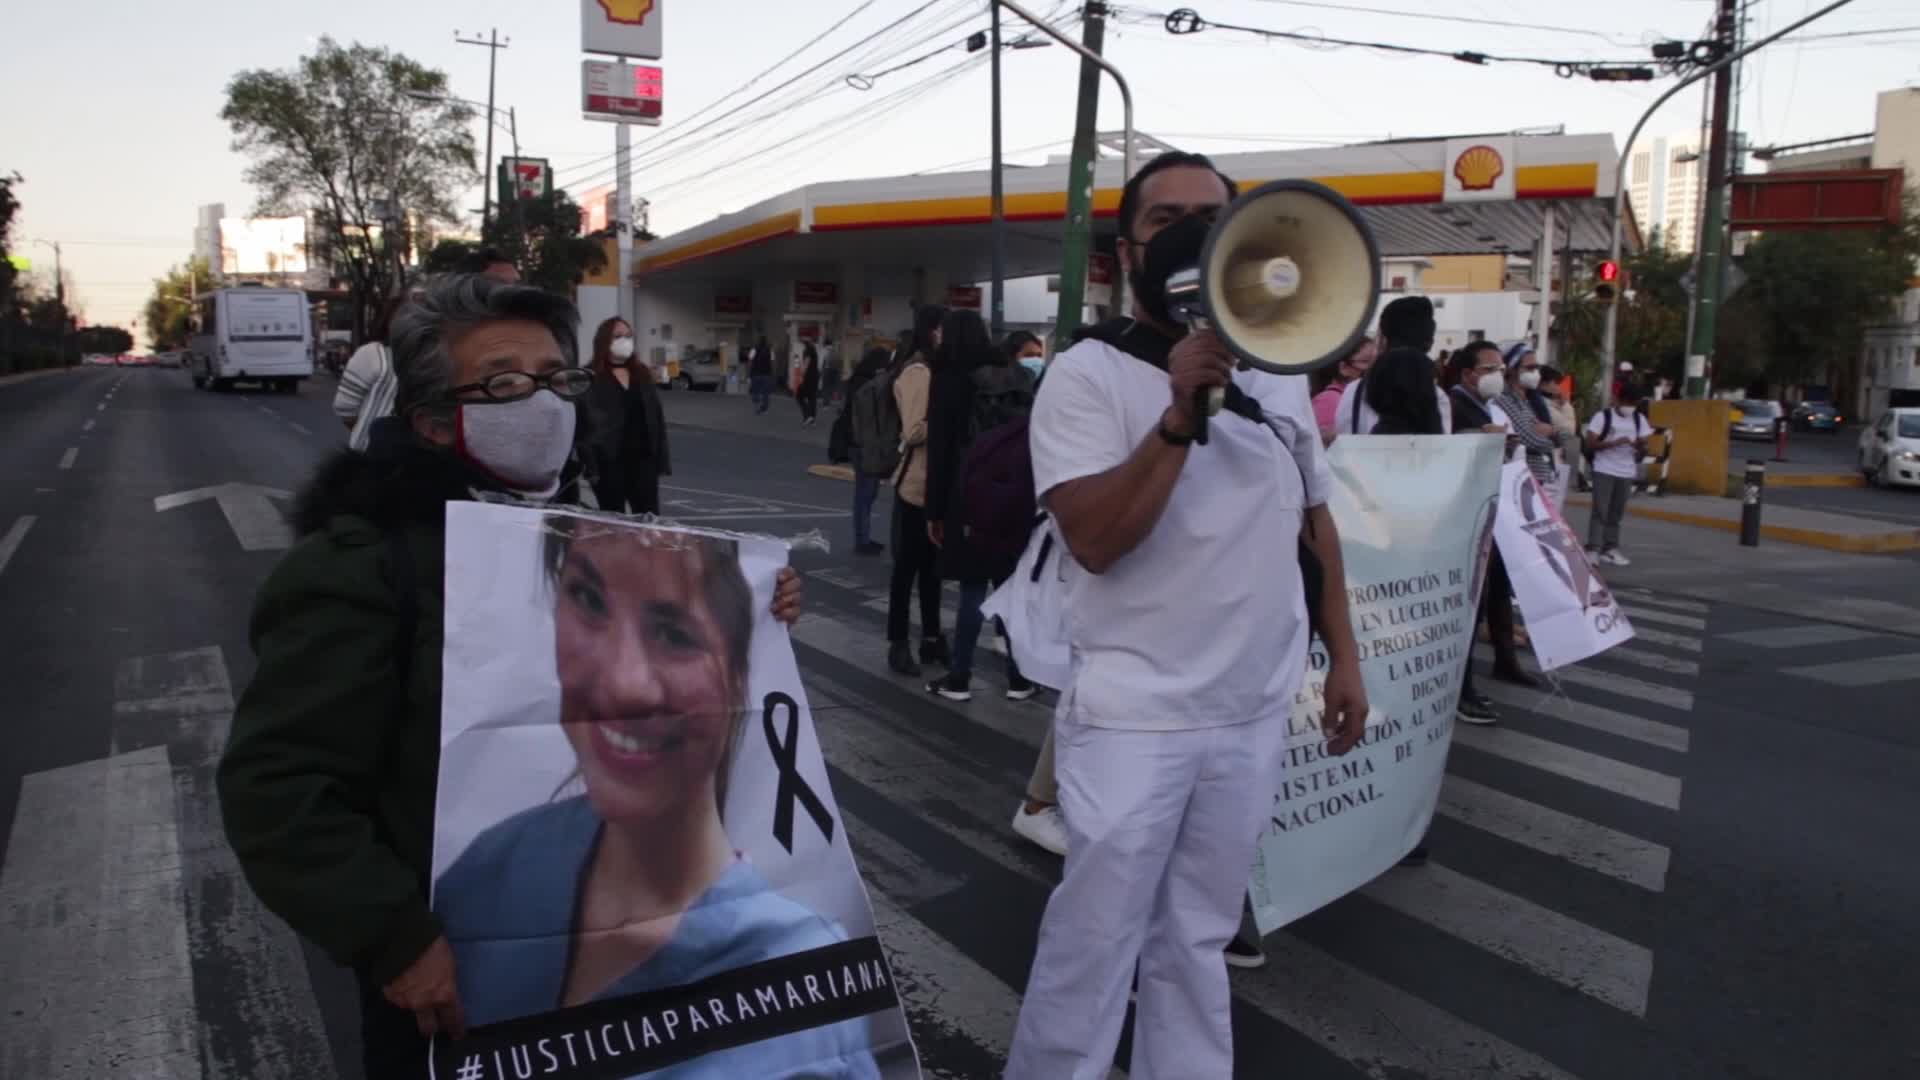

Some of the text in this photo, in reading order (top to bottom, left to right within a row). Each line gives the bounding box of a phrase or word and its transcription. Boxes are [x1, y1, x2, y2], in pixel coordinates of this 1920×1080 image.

[1347, 567, 1464, 605] PROMOCIÓN DE
[1360, 592, 1464, 632] EN LUCHA POR
[1372, 617, 1463, 657] PROFESIONAL
[1388, 642, 1463, 682] LABORAL
[1411, 671, 1449, 701] DIGNO
[1409, 709, 1425, 729] AL
[1394, 740, 1413, 764] DE
[1271, 783, 1384, 836] NACIONAL.
[455, 958, 887, 1080] #JUSTICIAPARAMARIANA
